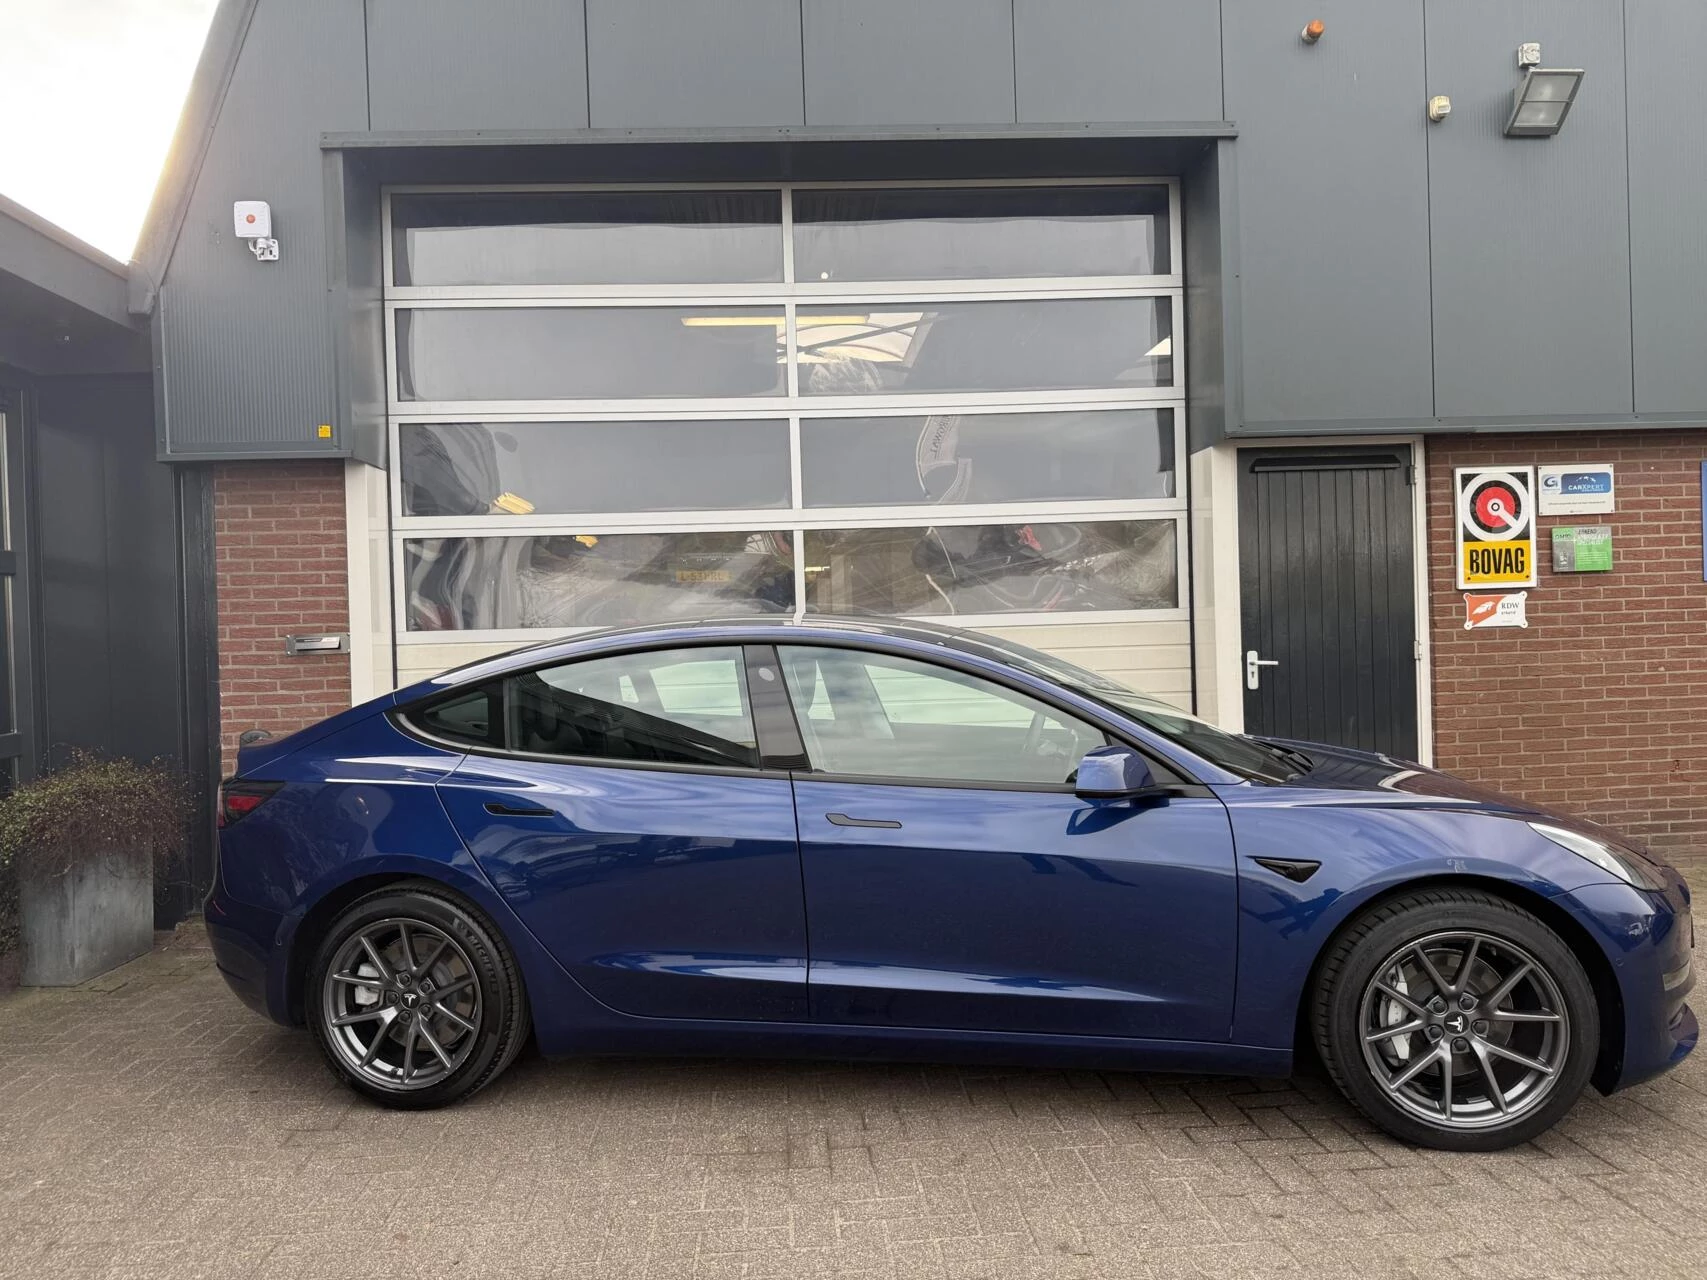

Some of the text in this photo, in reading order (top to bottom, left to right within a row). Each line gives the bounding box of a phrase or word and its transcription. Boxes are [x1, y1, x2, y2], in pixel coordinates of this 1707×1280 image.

[1568, 483, 1605, 491] CARXPERT
[1470, 547, 1525, 574] BOVAG
[1501, 602, 1520, 610] RDW
